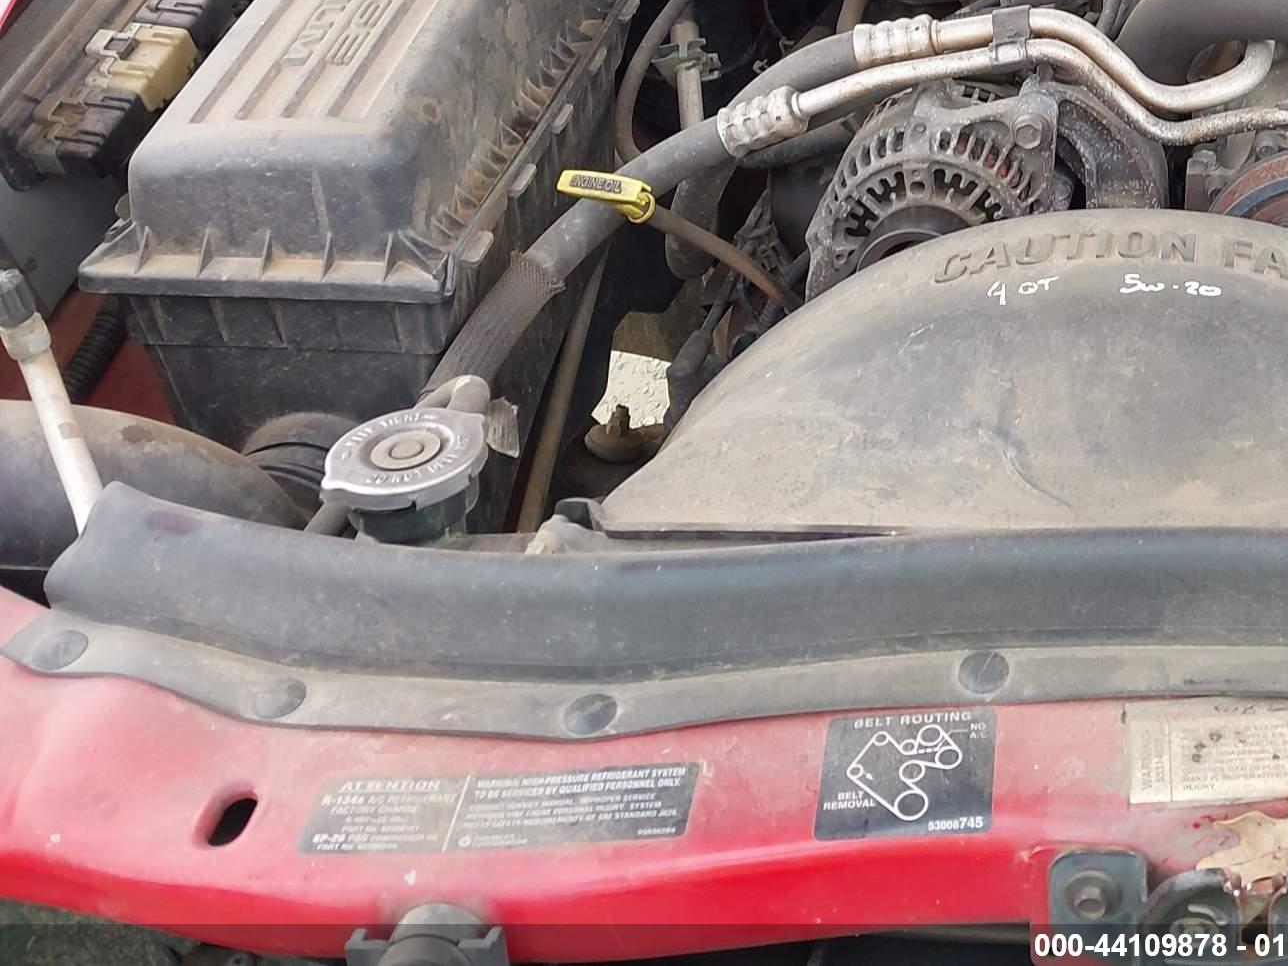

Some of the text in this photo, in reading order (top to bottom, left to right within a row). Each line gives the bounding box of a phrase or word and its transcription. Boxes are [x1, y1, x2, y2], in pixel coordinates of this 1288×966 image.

[570, 174, 622, 194] ENGINE OIL
[933, 229, 1199, 284] CAUTION
[854, 711, 972, 729] BELT ROUTING
[970, 723, 987, 731] NO
[545, 773, 590, 785] PRESSURE
[591, 769, 650, 782] REFRIGERANT
[651, 767, 687, 778] SYSTEM
[341, 779, 441, 792] ATTENTION
[558, 782, 604, 794] QUALIFIED
[605, 778, 655, 790] PERSONNEL
[837, 791, 864, 800] BELT
[823, 800, 876, 811] REMOVAL
